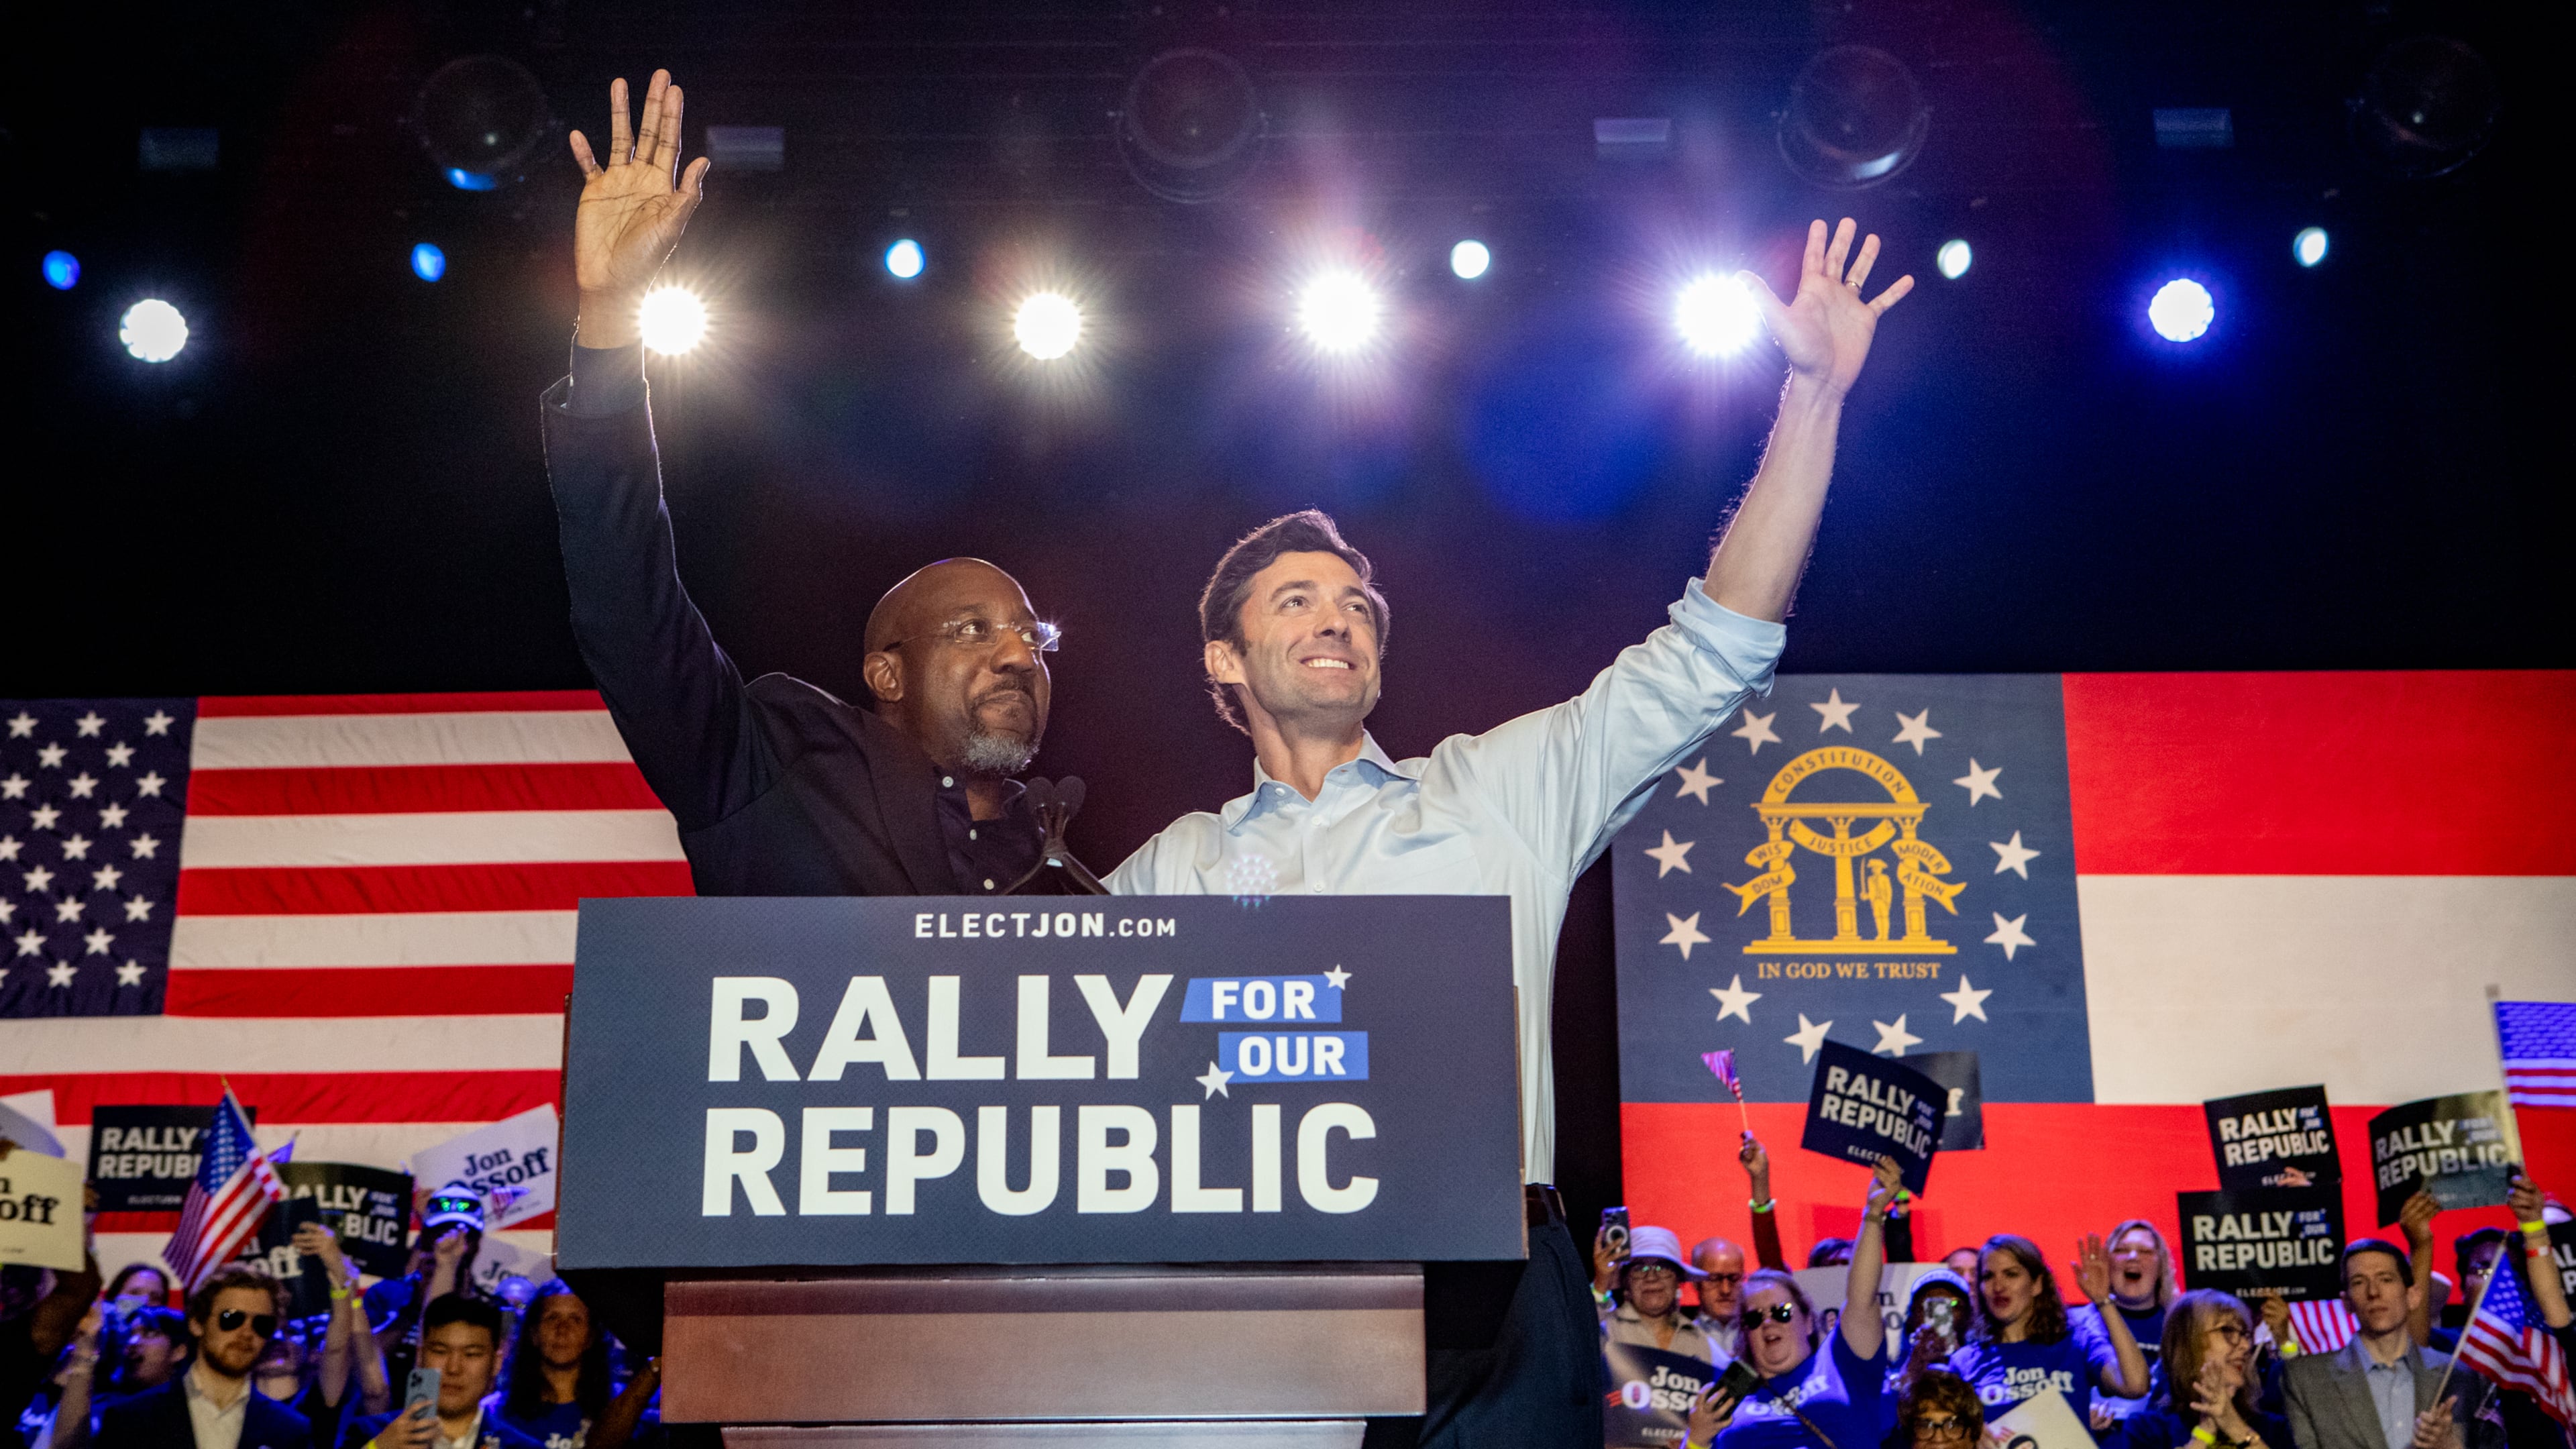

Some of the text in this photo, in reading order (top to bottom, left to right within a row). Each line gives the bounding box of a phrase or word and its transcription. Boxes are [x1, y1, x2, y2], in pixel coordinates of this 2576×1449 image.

[1774, 750, 1905, 794] CONSTITUTION
[1755, 843, 1782, 861] WIS
[1809, 836, 1874, 854] JUSTICE
[1898, 845, 1944, 873] MODER
[1752, 875, 1782, 894] DOM
[1903, 871, 1945, 896] ATION
[1758, 962, 1941, 978] IN GOD WE TRUST
[707, 973, 1317, 1083] RALLY FOR
[1238, 1035, 1347, 1077] OUR
[1826, 1065, 1915, 1116] RALLY
[101, 1126, 201, 1152] RALLY
[1820, 1093, 1932, 1160] REPUBLIC
[2218, 1108, 2298, 1142] RALLY
[2224, 1130, 2330, 1167] REPUBLIC
[2375, 1119, 2456, 1163] RALLY
[97, 1153, 203, 1179] REPUB
[445, 1146, 551, 1197] ssoff
[464, 1148, 513, 1177] Jon
[701, 1102, 1380, 1217] REPUBLIC
[2379, 1142, 2508, 1191] REPUBLIC
[0, 1194, 60, 1224] off
[294, 1184, 368, 1211] ALLY
[344, 1213, 399, 1246] BLIC
[2193, 1211, 2293, 1241] RALLY
[2196, 1238, 2334, 1271] REPUBLIC
[1650, 1365, 1701, 1393] Jon
[2003, 1366, 2045, 1385] Jon
[1621, 1380, 1697, 1411] Oss
